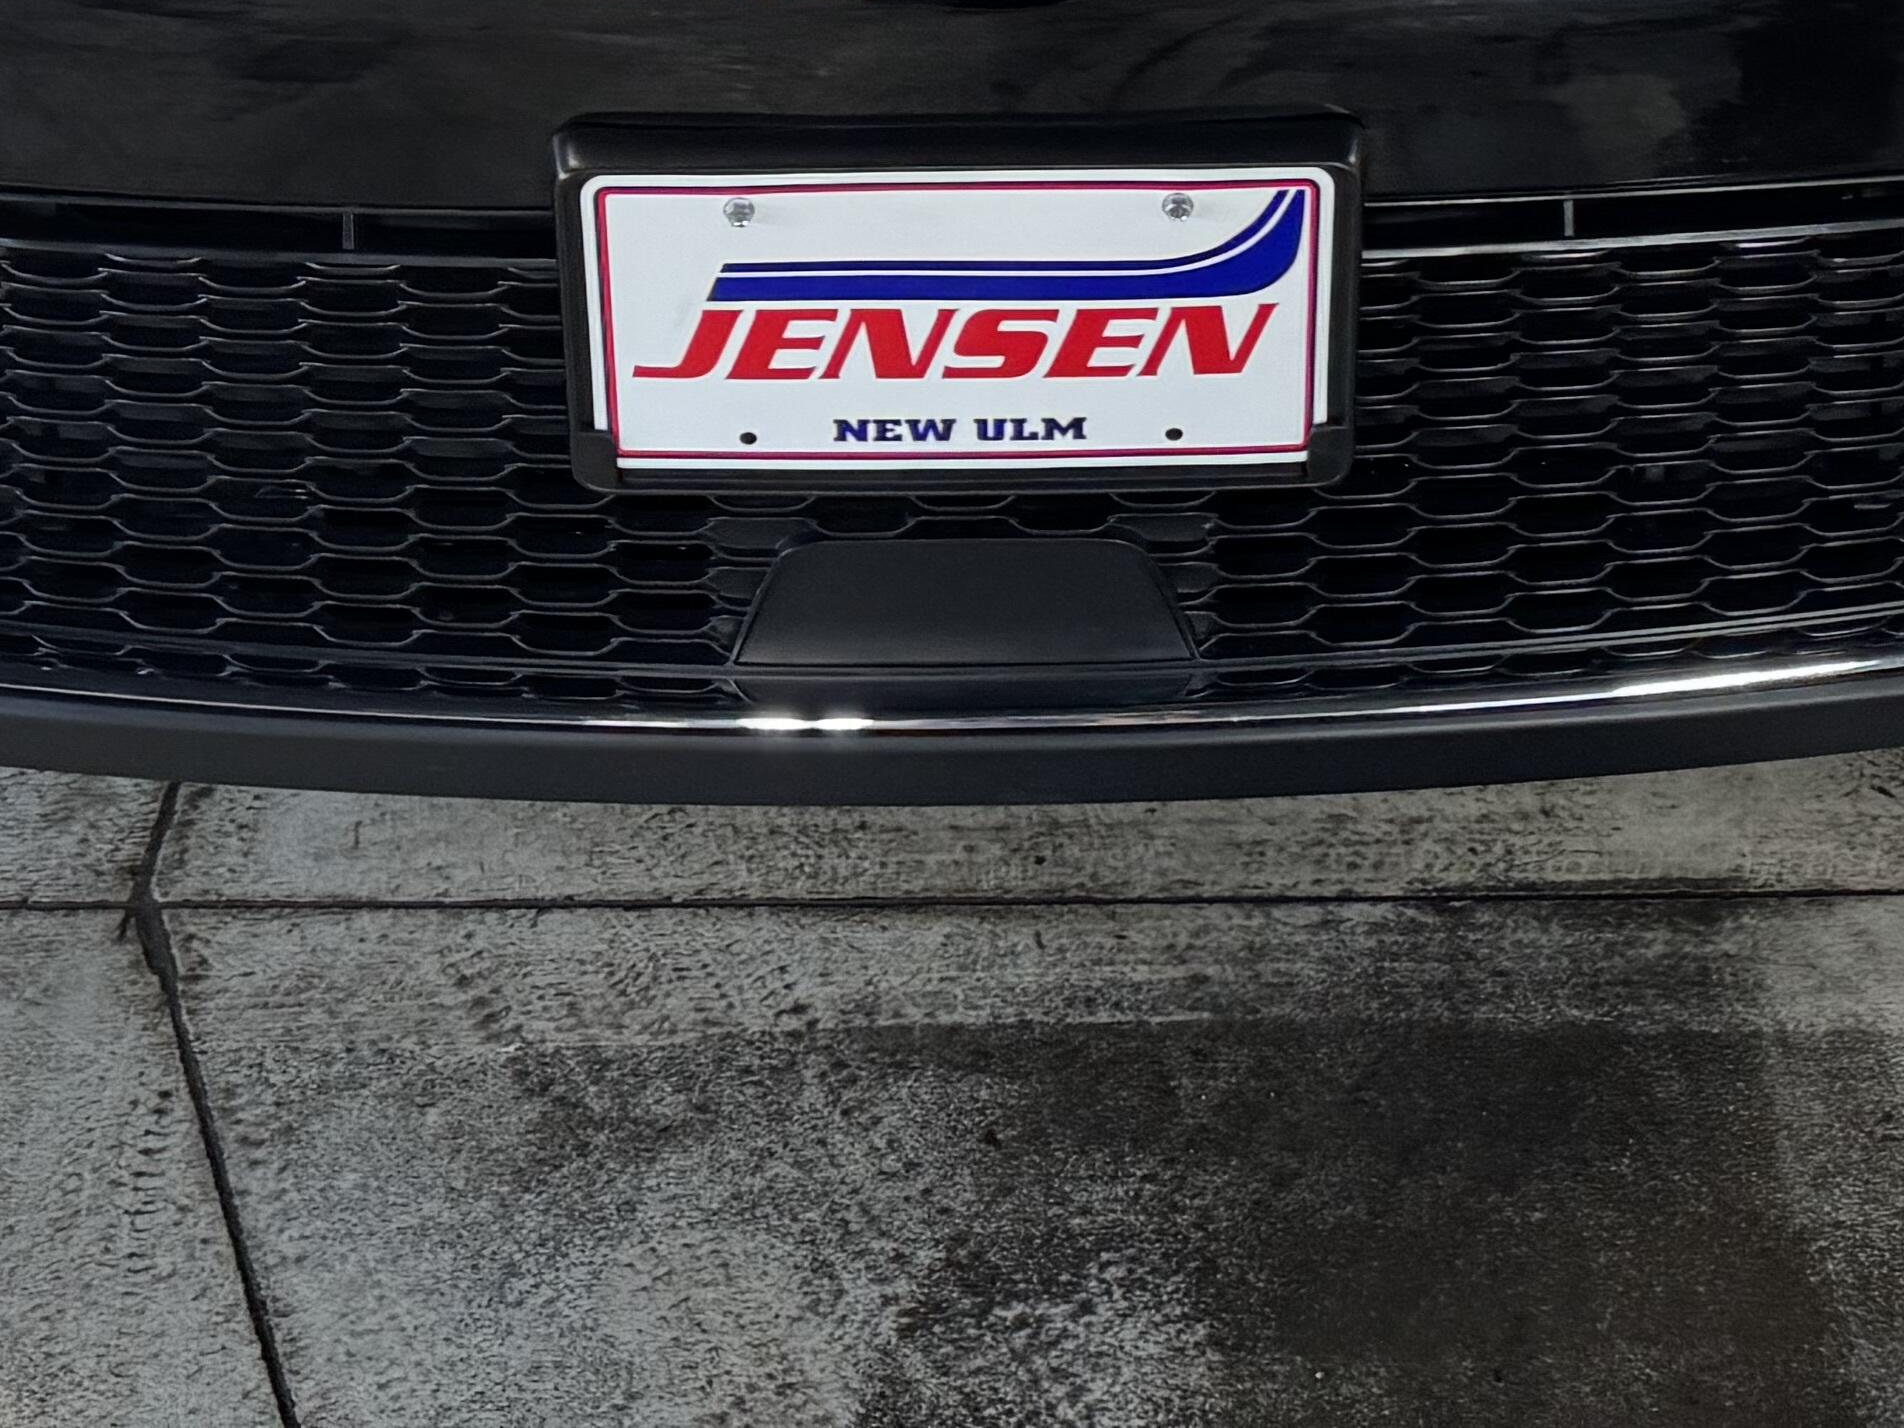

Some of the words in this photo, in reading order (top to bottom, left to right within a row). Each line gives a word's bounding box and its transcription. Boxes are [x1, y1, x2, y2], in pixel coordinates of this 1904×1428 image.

[632, 302, 1278, 380] JENSEN
[833, 418, 954, 443] NEW
[975, 416, 1087, 442] ULM
